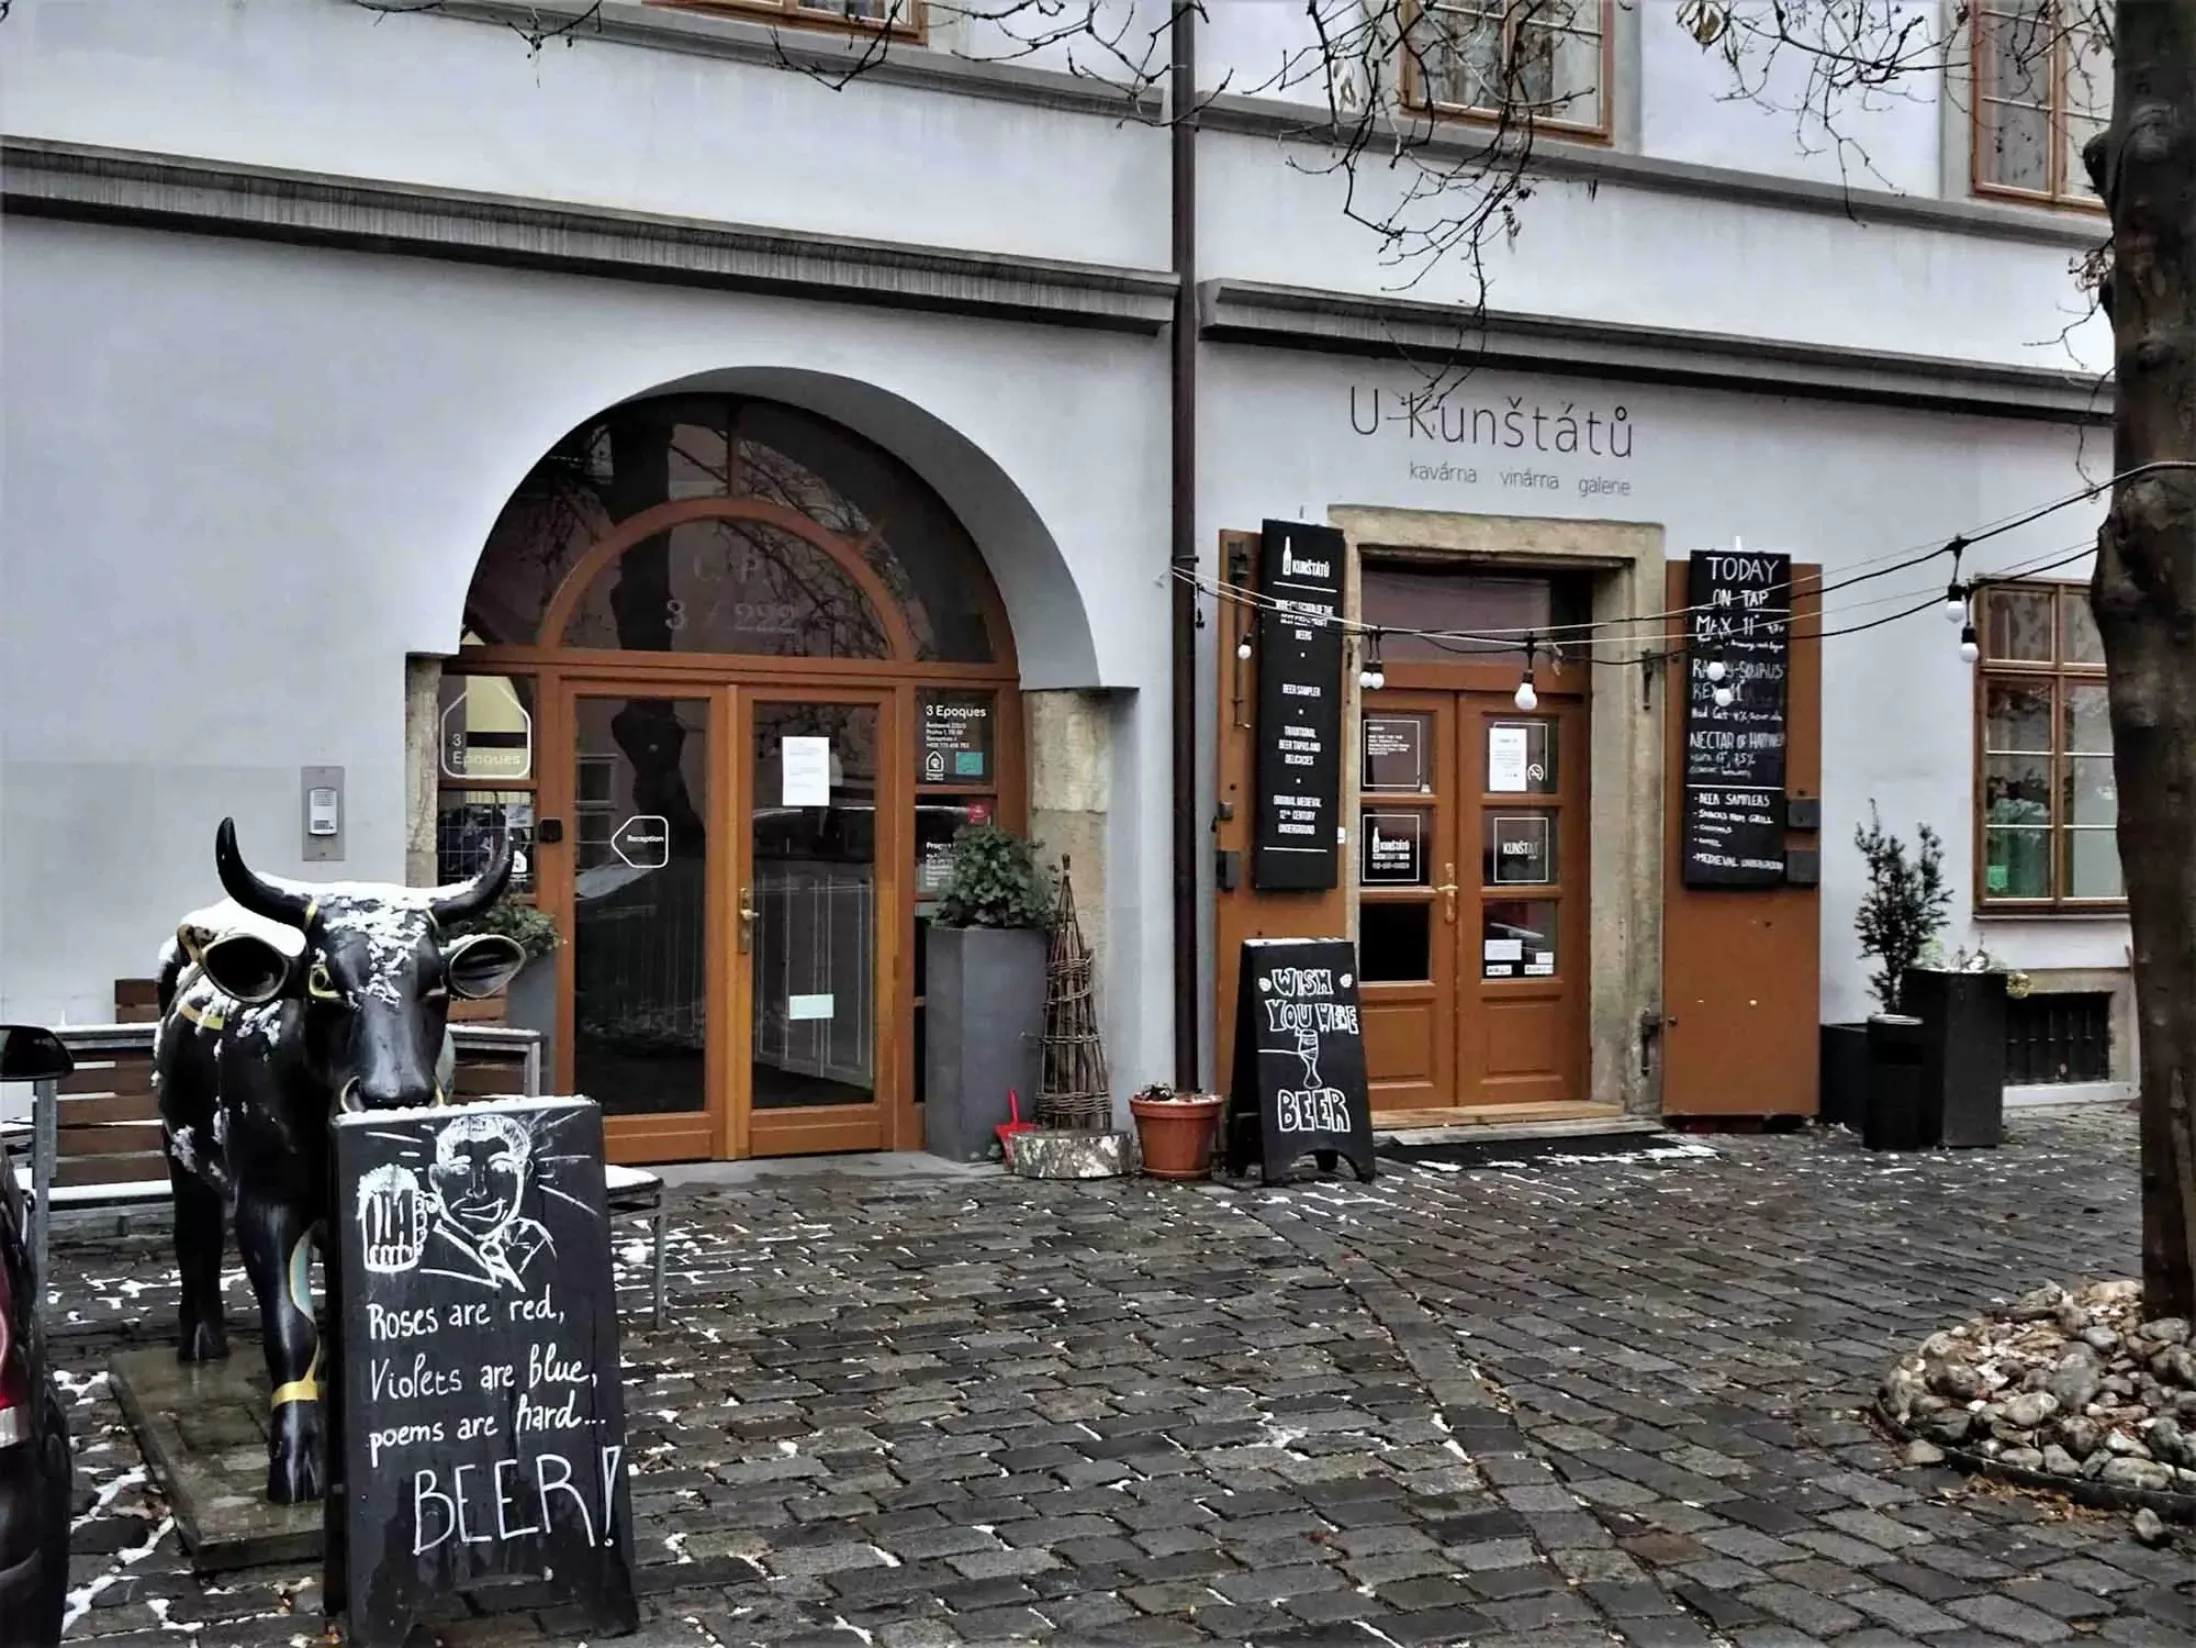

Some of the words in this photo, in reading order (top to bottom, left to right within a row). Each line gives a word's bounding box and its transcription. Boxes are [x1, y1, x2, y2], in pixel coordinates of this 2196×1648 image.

[1351, 386, 1379, 436] U
[1409, 391, 1632, 457] Kunštátů
[1410, 462, 1477, 484] kavárna
[1500, 467, 1559, 490] vinárna
[1705, 556, 1779, 584] TODAY
[1712, 588, 1732, 607] ON
[1740, 589, 1769, 608] TAP
[926, 704, 934, 716] 3
[936, 704, 987, 719] Epoques
[452, 733, 462, 747] 3
[1690, 731, 1735, 750] NECTAR
[452, 751, 521, 769] Epoques
[627, 834, 665, 844] Reception
[1271, 967, 1335, 997] WISH
[1264, 998, 1313, 1033] YOU
[1277, 1088, 1351, 1133] BEER
[366, 1303, 439, 1341] Roses
[449, 1303, 491, 1328] are
[510, 1284, 564, 1324] red,
[371, 1353, 463, 1402] Violets
[480, 1364, 516, 1391] are
[528, 1342, 598, 1389] blue,
[369, 1421, 445, 1468] poems
[457, 1415, 499, 1440] are
[515, 1389, 606, 1436] hard...
[413, 1446, 624, 1556] BEER!
